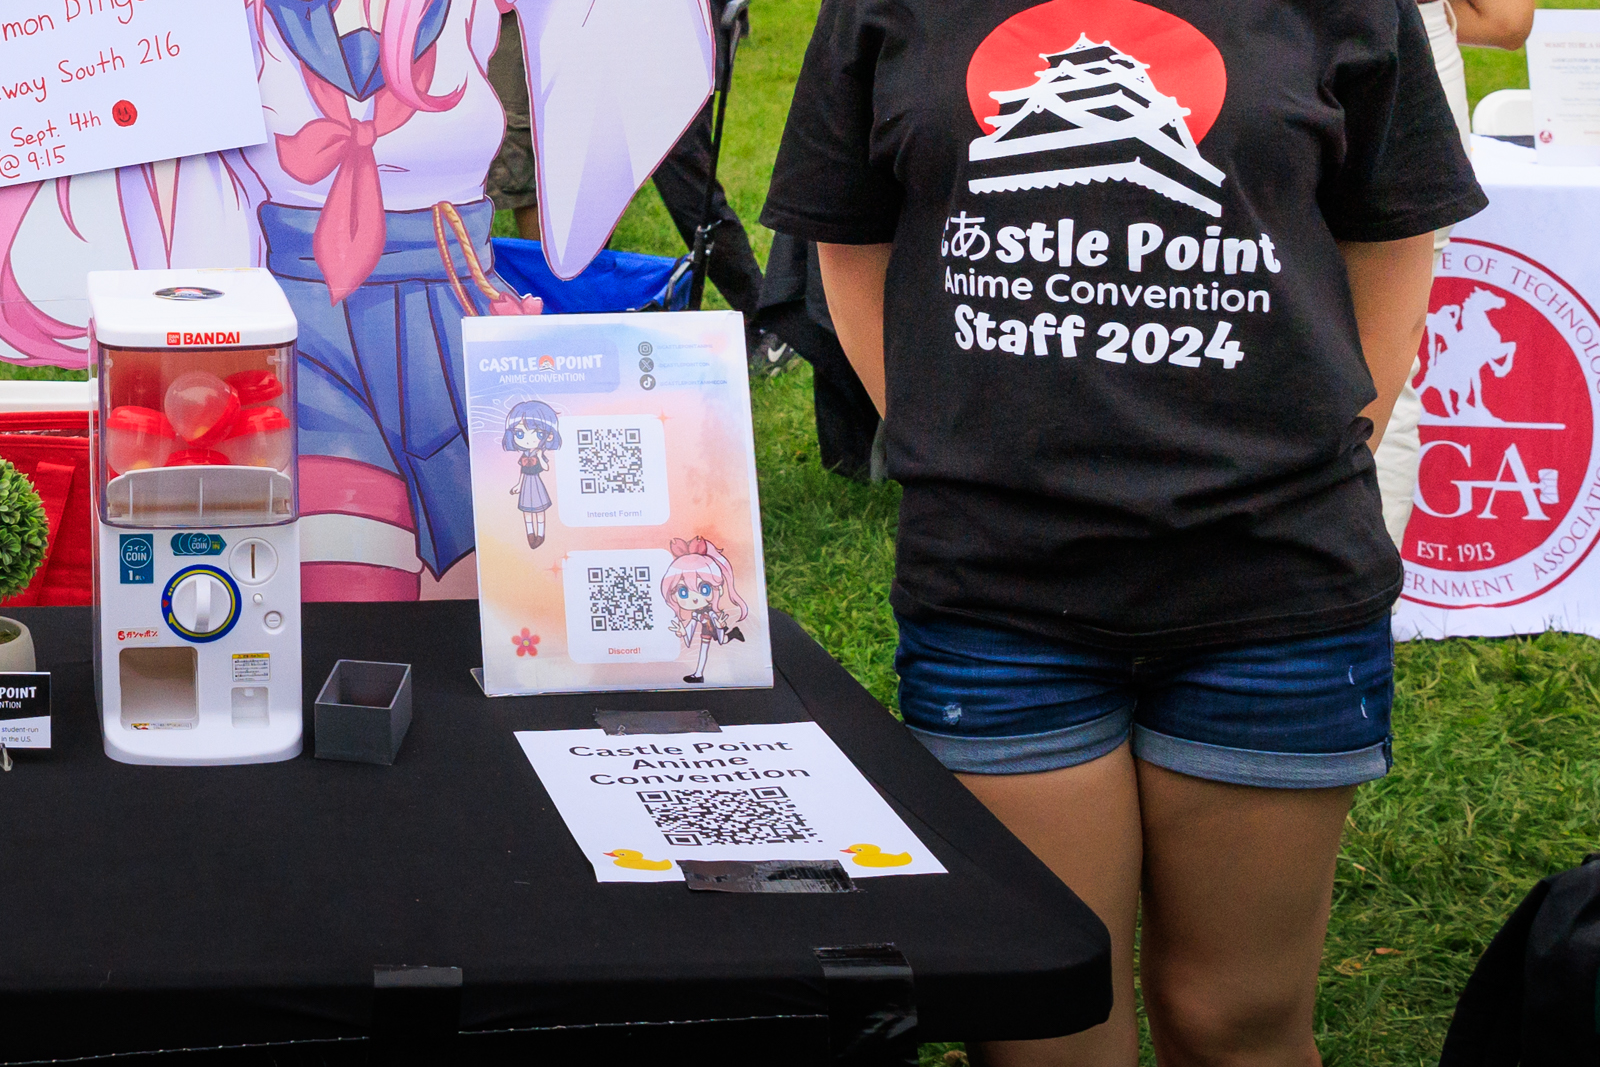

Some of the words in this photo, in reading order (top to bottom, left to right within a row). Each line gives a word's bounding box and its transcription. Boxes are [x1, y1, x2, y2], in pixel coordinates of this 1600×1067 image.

[58, 46, 125, 83] South
[138, 32, 180, 65] 216
[10, 122, 60, 151] Sept.
[69, 111, 101, 133] 4th
[27, 145, 66, 171] 9:15
[1128, 223, 1281, 275] Point
[1464, 254, 1498, 275] OF
[945, 267, 1033, 301] Anime
[1045, 274, 1270, 312] Convention
[183, 332, 240, 345] BANDAI
[954, 304, 1085, 357] Staff
[1096, 321, 1244, 369] 2024
[479, 356, 538, 374] CASTLE
[556, 353, 603, 371] POINT
[499, 373, 527, 383] ANIME
[529, 372, 585, 383] CONVENTION
[587, 510, 616, 519] Interest
[619, 509, 642, 518] Form!
[126, 552, 147, 561] COIN
[1417, 540, 1452, 562] EST.
[1457, 542, 1495, 562] 1913
[608, 646, 641, 655] Discord!
[569, 743, 684, 757] Castle
[693, 740, 794, 754] Point
[632, 753, 750, 770] Anime
[589, 767, 811, 786] Convention
